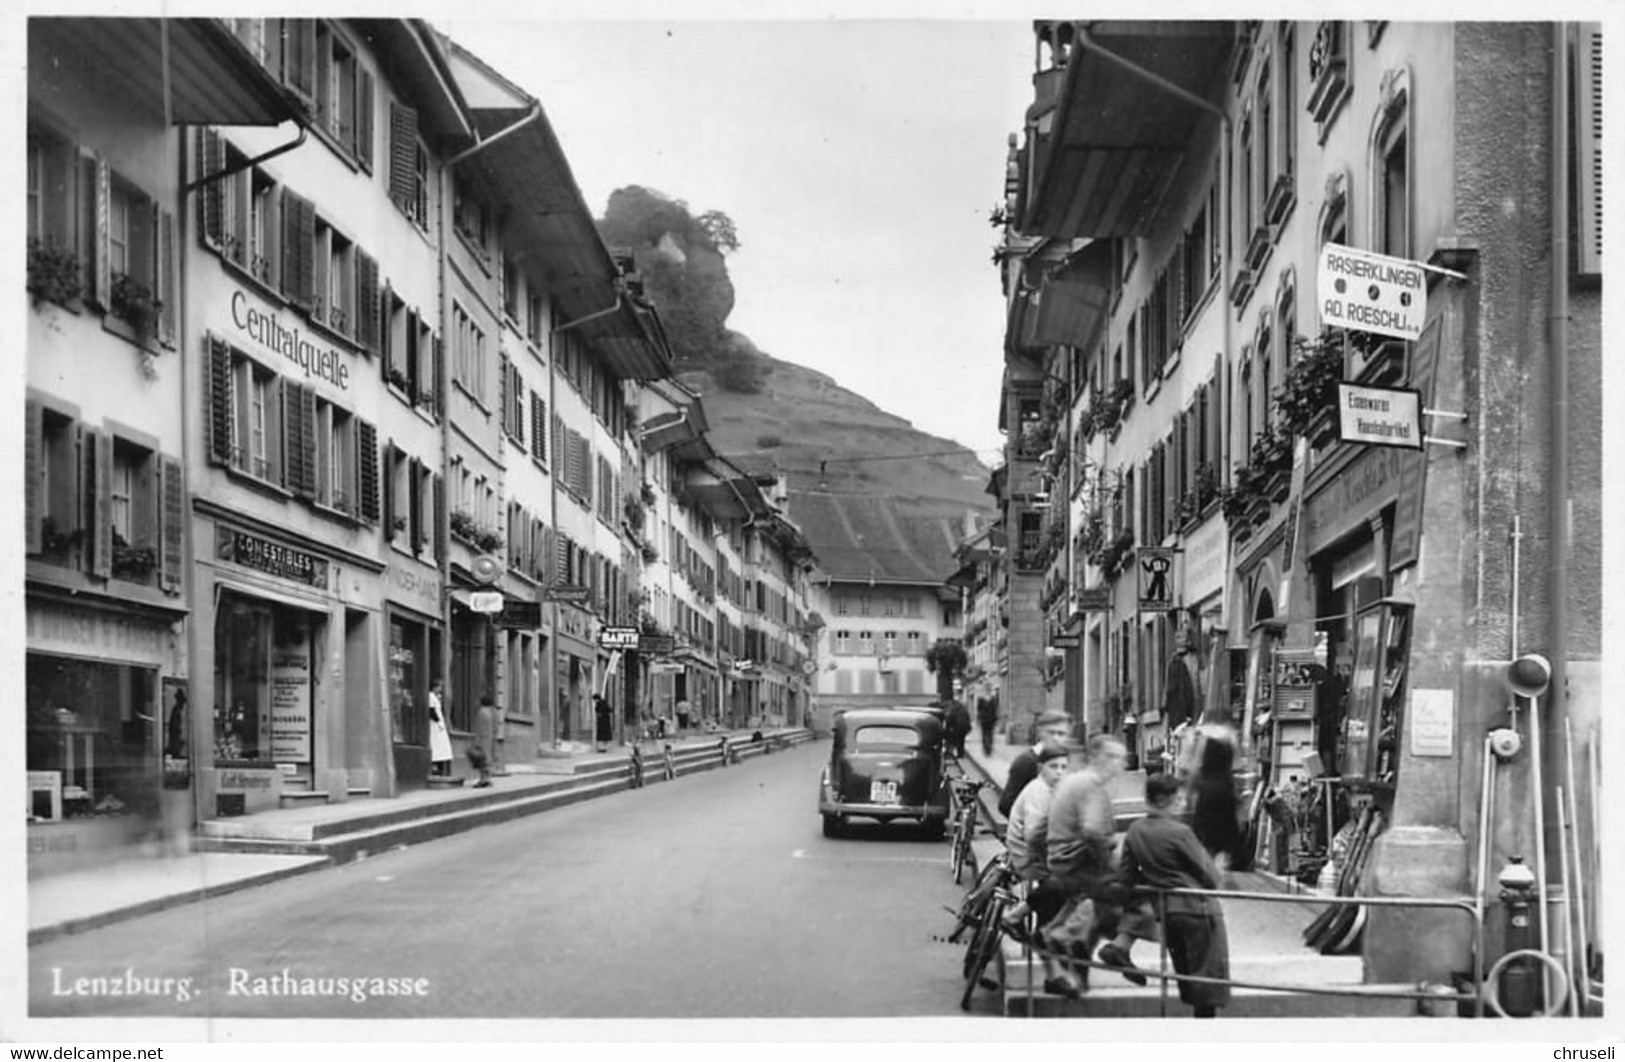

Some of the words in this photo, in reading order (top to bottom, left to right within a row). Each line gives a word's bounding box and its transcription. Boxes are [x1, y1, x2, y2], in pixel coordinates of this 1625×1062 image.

[1327, 253, 1422, 290] RASIERKLINGEN
[1325, 299, 1345, 319] AD.
[1347, 302, 1407, 331] ROESCHLI
[231, 289, 349, 391] Centralquelle
[239, 534, 312, 571] COMESTIBLES
[602, 632, 639, 644] BARTH
